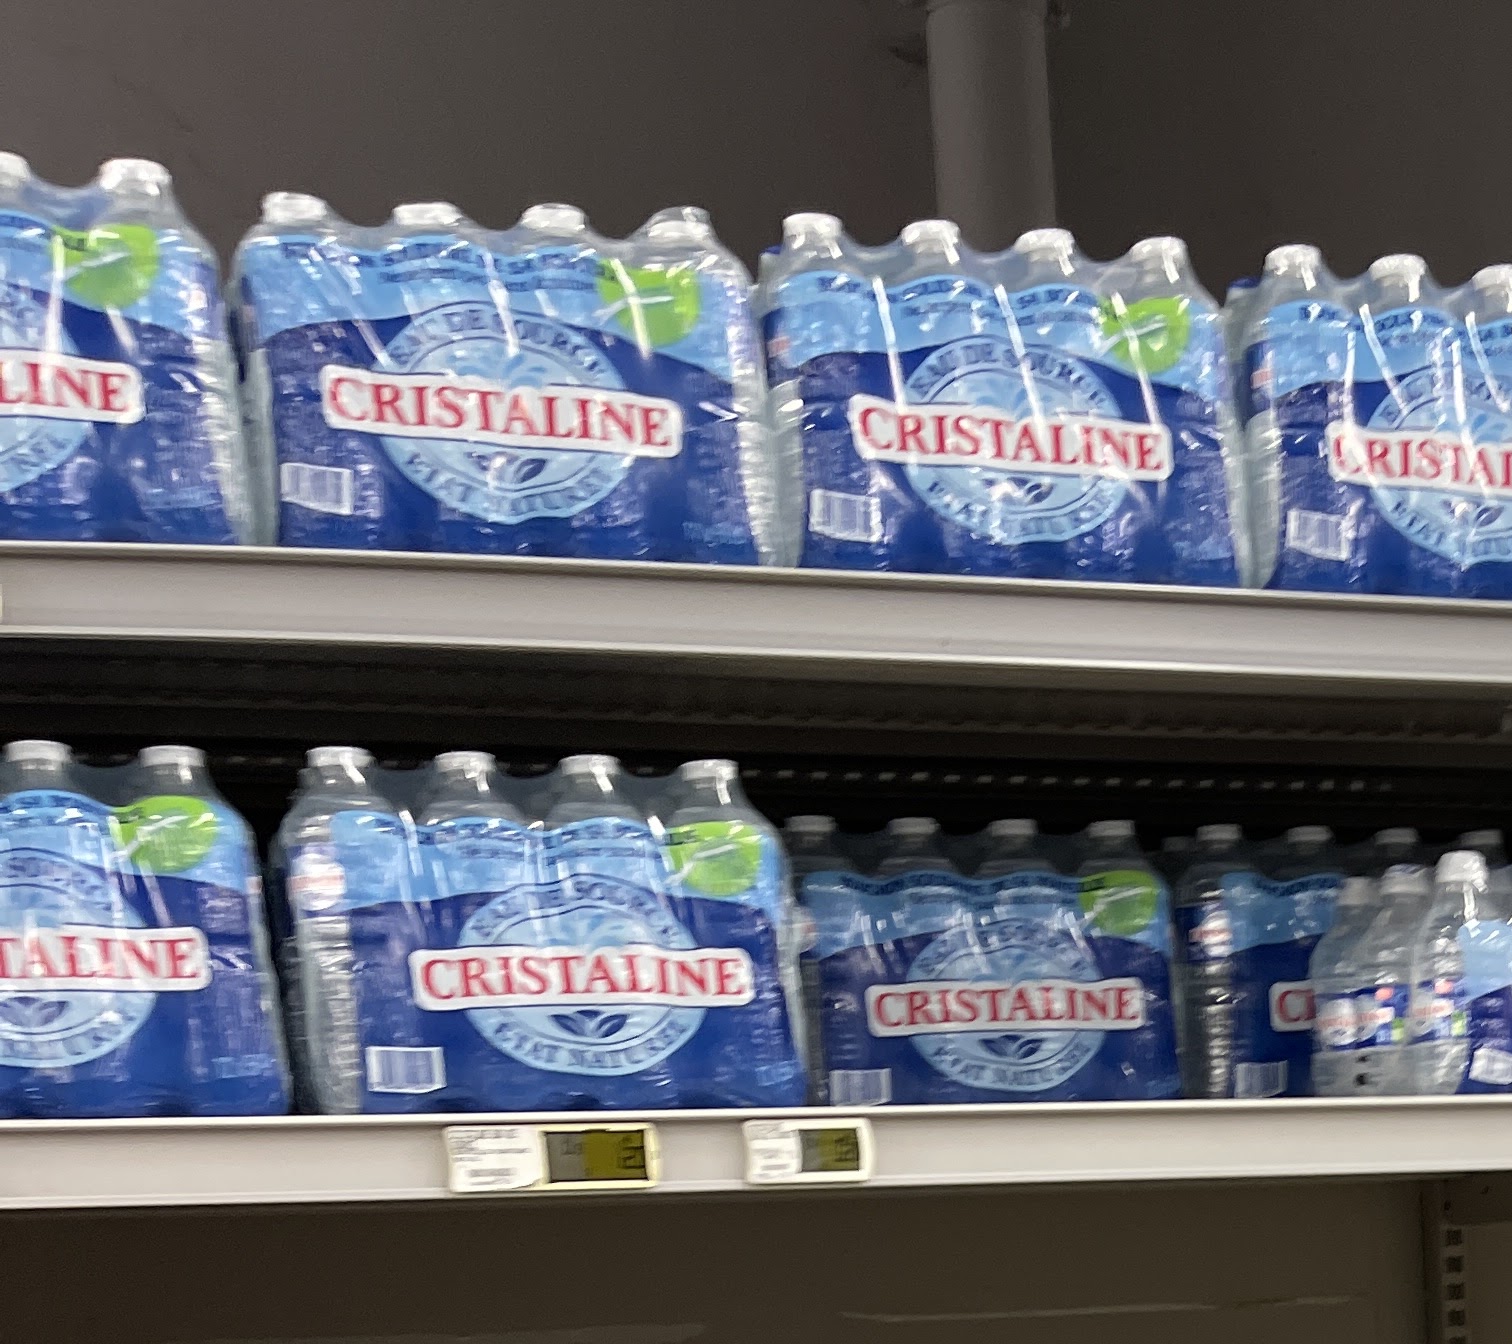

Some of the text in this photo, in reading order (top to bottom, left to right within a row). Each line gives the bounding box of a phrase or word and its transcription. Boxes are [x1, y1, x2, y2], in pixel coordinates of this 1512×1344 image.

[329, 376, 672, 448] CRISTALINE
[858, 406, 1163, 471] CRISTALINE
[421, 952, 746, 1000] CRISTALINE
[874, 986, 1139, 1027] CRISTALINE
